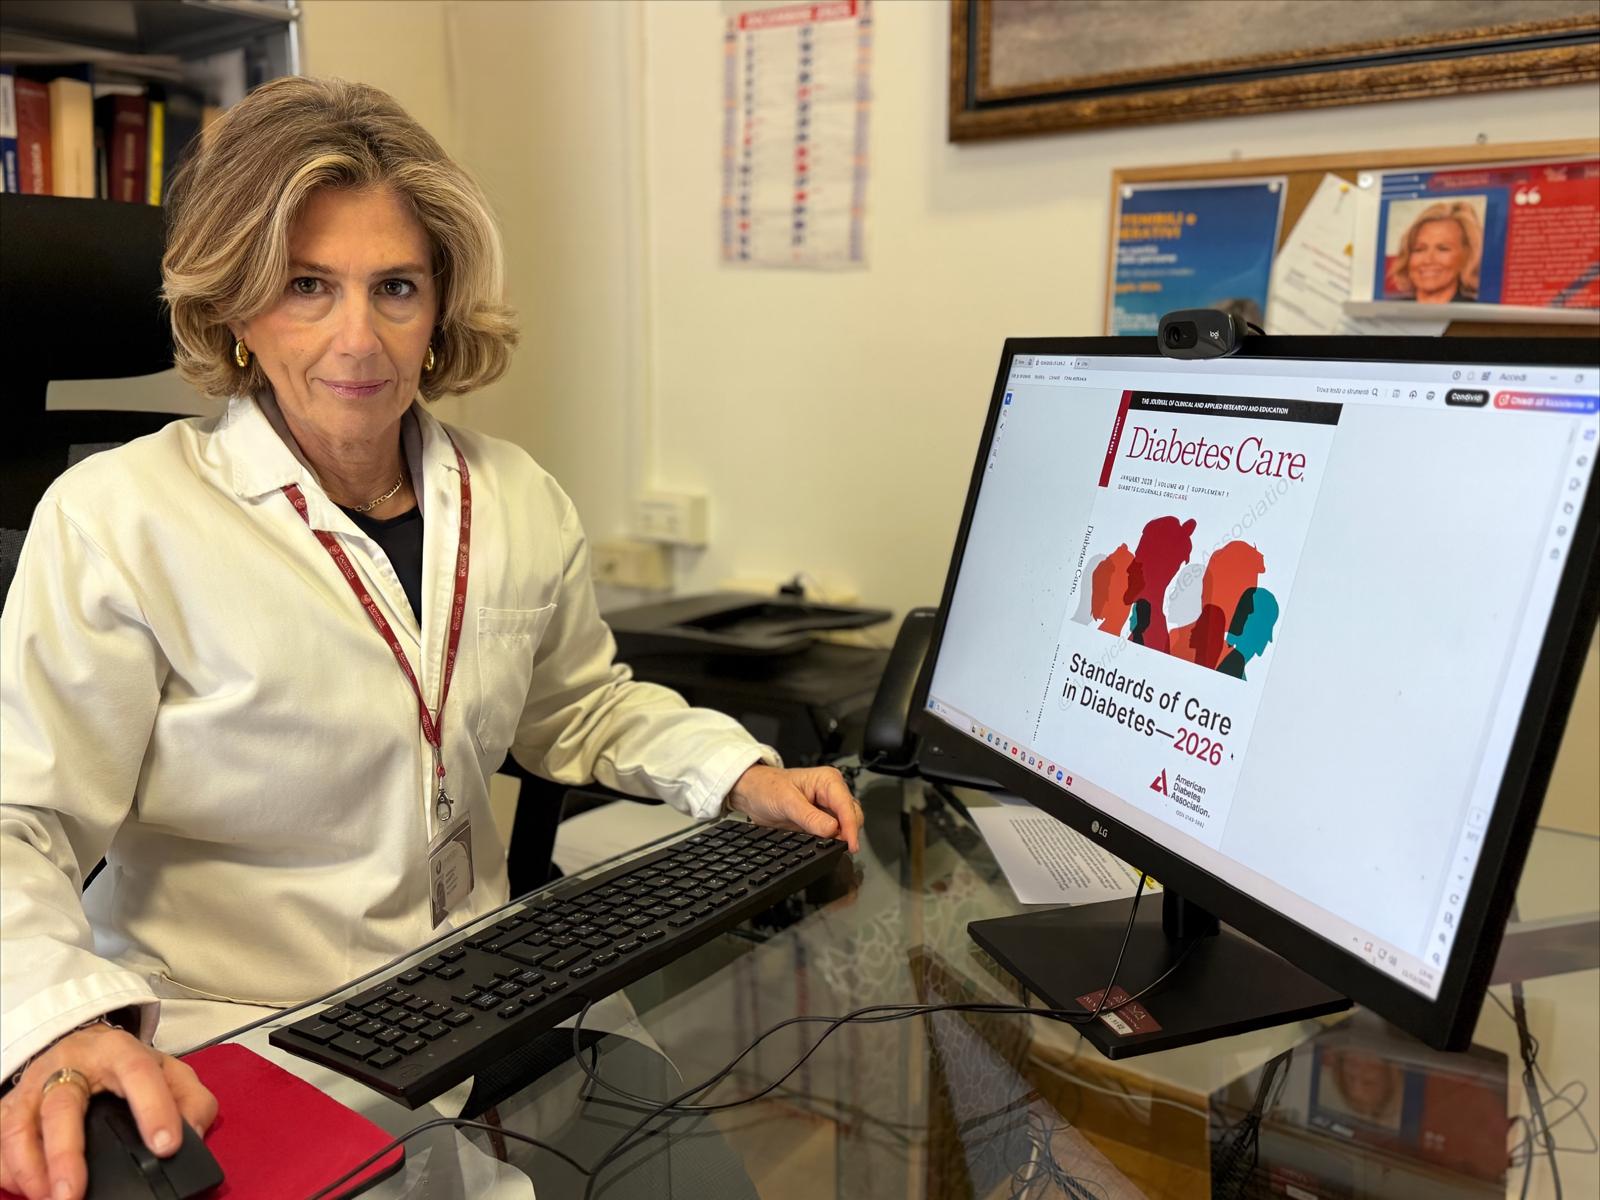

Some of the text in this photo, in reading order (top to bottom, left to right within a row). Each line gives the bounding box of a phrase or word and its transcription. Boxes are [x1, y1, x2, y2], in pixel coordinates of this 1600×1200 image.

[1175, 400, 1194, 408] CLINICAL
[1194, 401, 1204, 409] AND
[1204, 402, 1223, 410] APPLIED
[1222, 403, 1248, 411] RESEARCH
[1259, 406, 1289, 415] EDUCATION
[1451, 392, 1484, 403] Condividi
[1126, 426, 1234, 471] Diabetes
[1120, 474, 1140, 483] JANUARY
[1158, 481, 1177, 490] VOLUME
[1191, 486, 1225, 497] SUPPLEMENT
[1077, 525, 1095, 568] Diabetes
[1062, 677, 1077, 702] in
[1069, 653, 1232, 736] Standards of Care
[1173, 782, 1202, 803] Diabetes
[1175, 773, 1207, 795] American
[1098, 825, 1109, 838] LG
